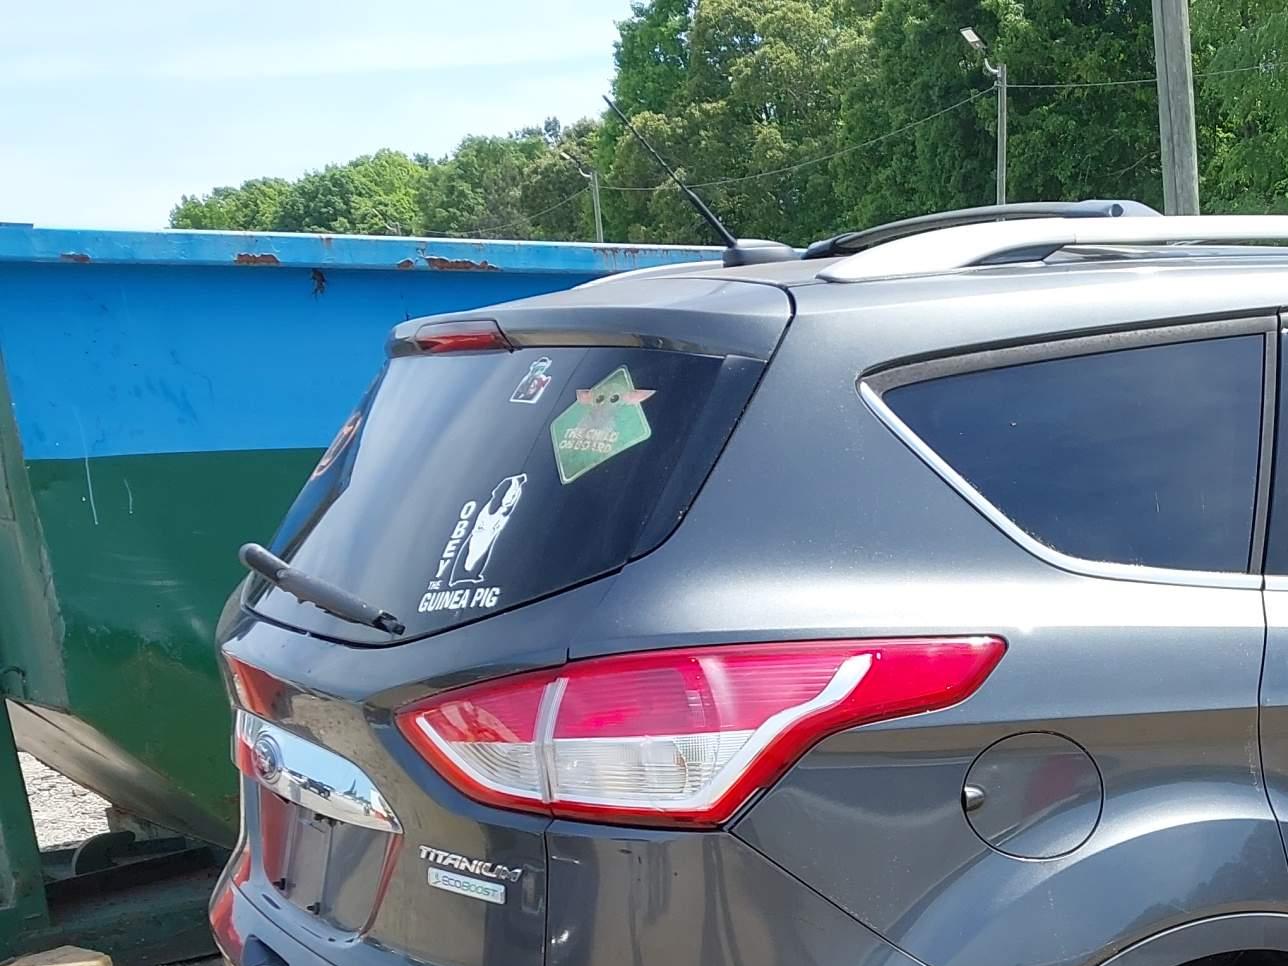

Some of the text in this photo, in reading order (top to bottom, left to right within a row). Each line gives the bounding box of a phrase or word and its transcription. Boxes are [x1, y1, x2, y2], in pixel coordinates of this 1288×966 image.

[436, 500, 477, 578] OBEY
[418, 587, 501, 613] GUINEA PIG
[427, 580, 443, 590] THE
[419, 845, 523, 882] TITANIUM
